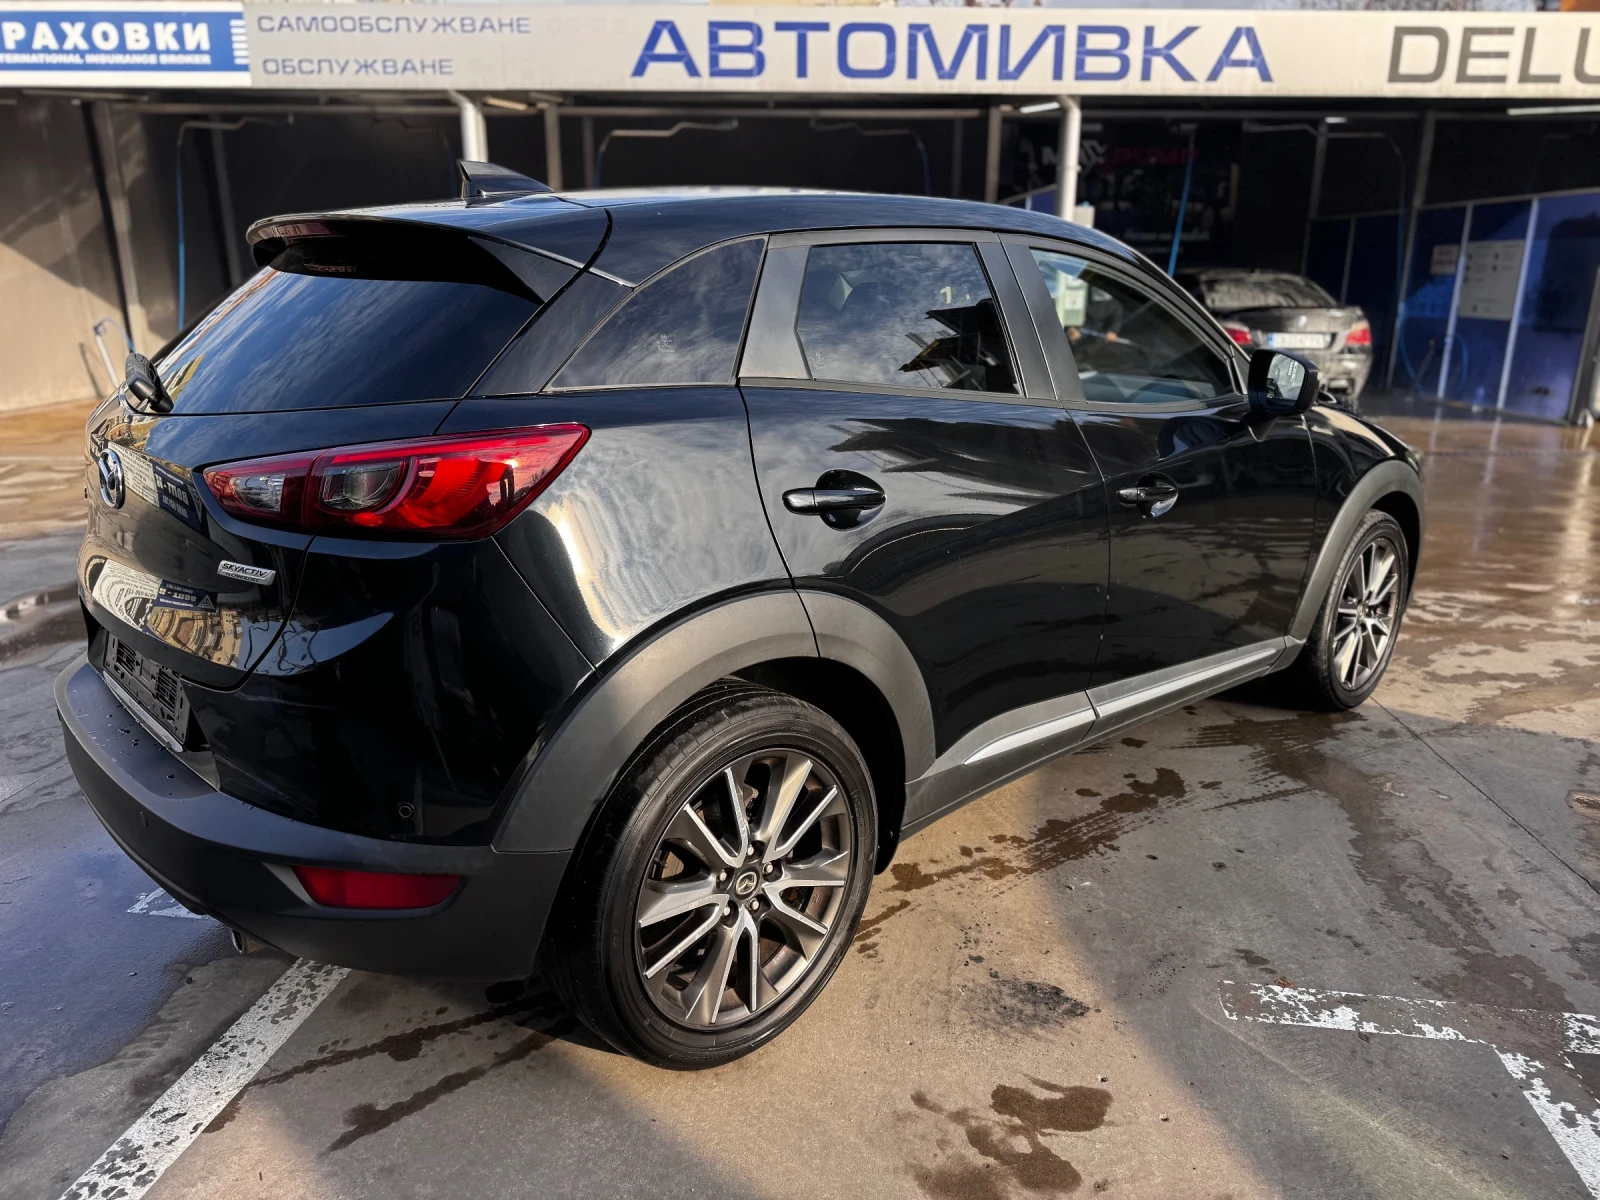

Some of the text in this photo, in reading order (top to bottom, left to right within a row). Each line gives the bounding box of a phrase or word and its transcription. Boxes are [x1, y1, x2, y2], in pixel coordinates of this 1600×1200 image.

[257, 15, 532, 34] САМООБСЛУЖВАНЕ
[1, 21, 211, 51] РАХОВКИ
[85, 53, 157, 65] INSURANCE
[159, 53, 212, 65] BROKER
[631, 20, 1274, 83] АВТОМИВКА
[262, 58, 454, 76] ОБСЛУЖВАНЕ
[221, 562, 268, 577] SKYACTIV
